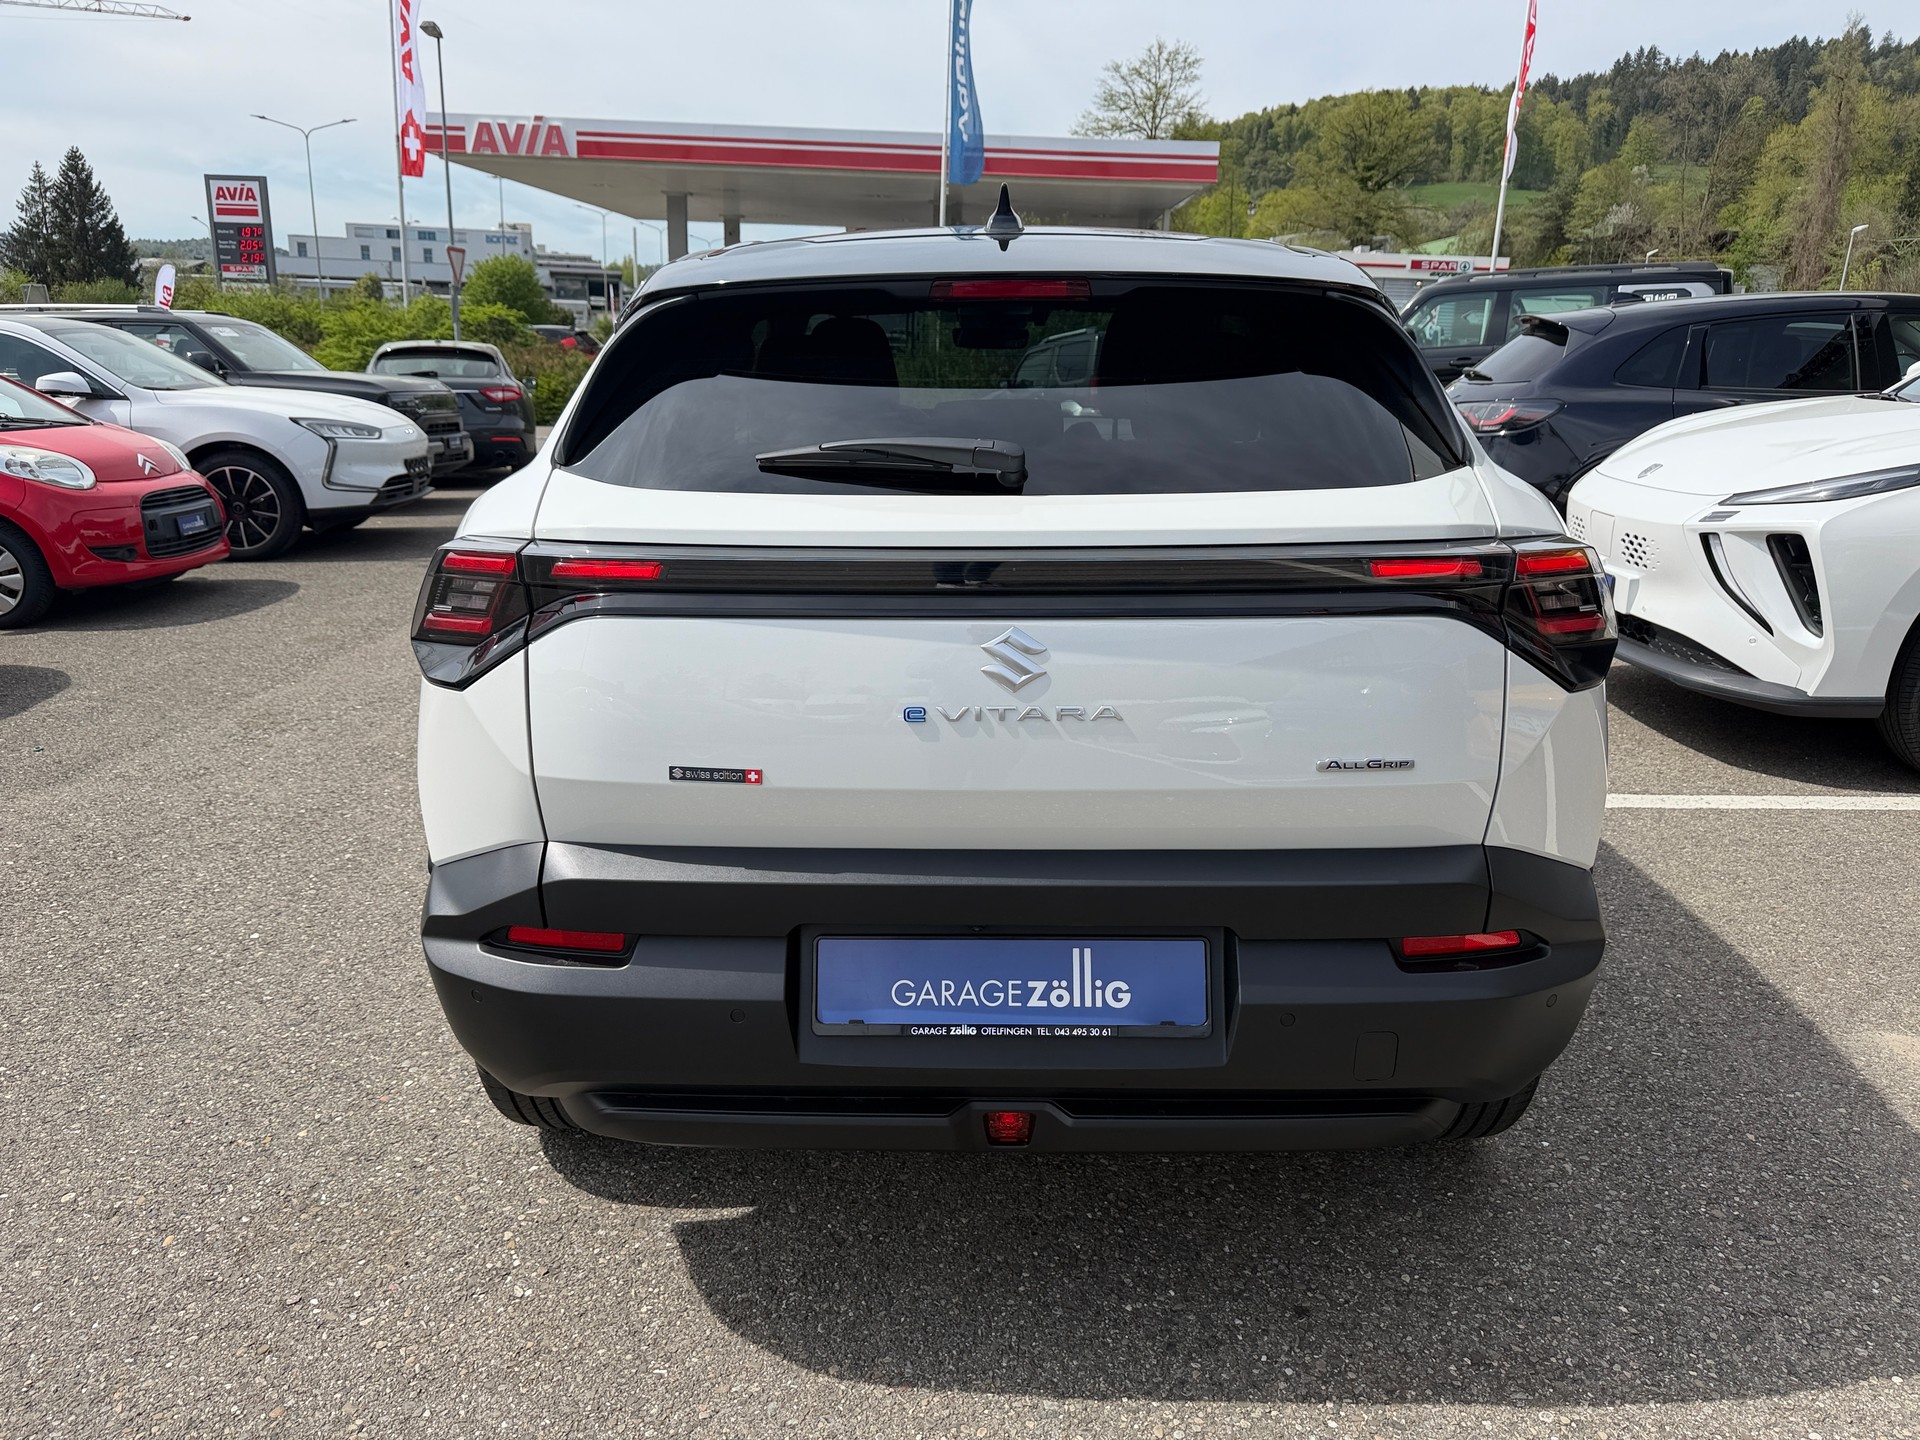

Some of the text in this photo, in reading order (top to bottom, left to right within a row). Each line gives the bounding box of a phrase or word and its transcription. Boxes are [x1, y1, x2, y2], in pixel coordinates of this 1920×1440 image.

[1421, 260, 1457, 270] SPAR
[935, 705, 1124, 722] VITARA
[685, 769, 743, 780] swiss edition
[891, 979, 1022, 1008] GARAGE
[911, 1026, 947, 1035] GARAGE
[981, 1027, 1032, 1036] OTELFINGEN
[1054, 1028, 1070, 1036] 043
[1072, 1028, 1087, 1036] 495
[1089, 1028, 1100, 1036] 30
[1102, 1028, 1111, 1036] 61
